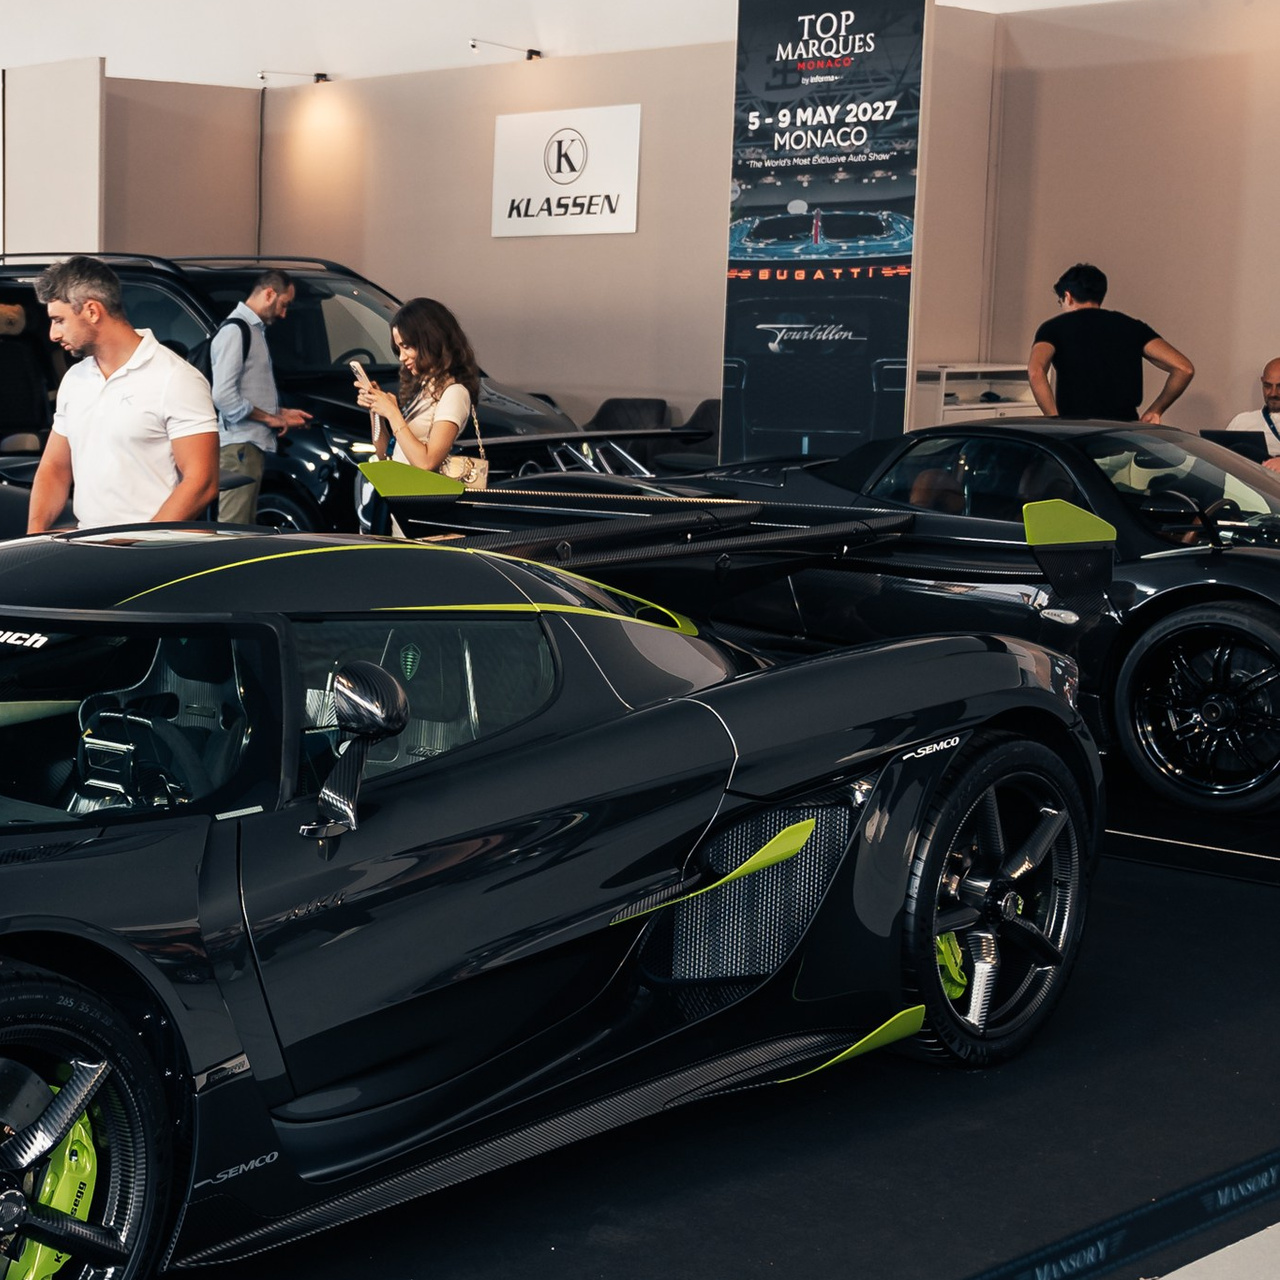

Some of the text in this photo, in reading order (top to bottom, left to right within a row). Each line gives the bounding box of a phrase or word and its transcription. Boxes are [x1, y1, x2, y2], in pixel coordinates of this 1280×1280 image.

[798, 10, 855, 40] TOP
[775, 33, 875, 61] MARQUES
[801, 77, 810, 85] by
[748, 111, 760, 130] 5
[778, 108, 791, 128] 9
[796, 104, 841, 127] MAY
[844, 100, 897, 123] 2027
[774, 126, 868, 151] MONACO
[792, 156, 811, 166] Most
[812, 154, 846, 165] Exclusive
[847, 154, 867, 162] Auto
[507, 194, 620, 219] KLASSEN
[758, 267, 873, 280] BUGATTI
[756, 324, 868, 353] Tourbillon
[902, 737, 960, 760] SEMCO
[193, 1151, 279, 1189] SEMCO
